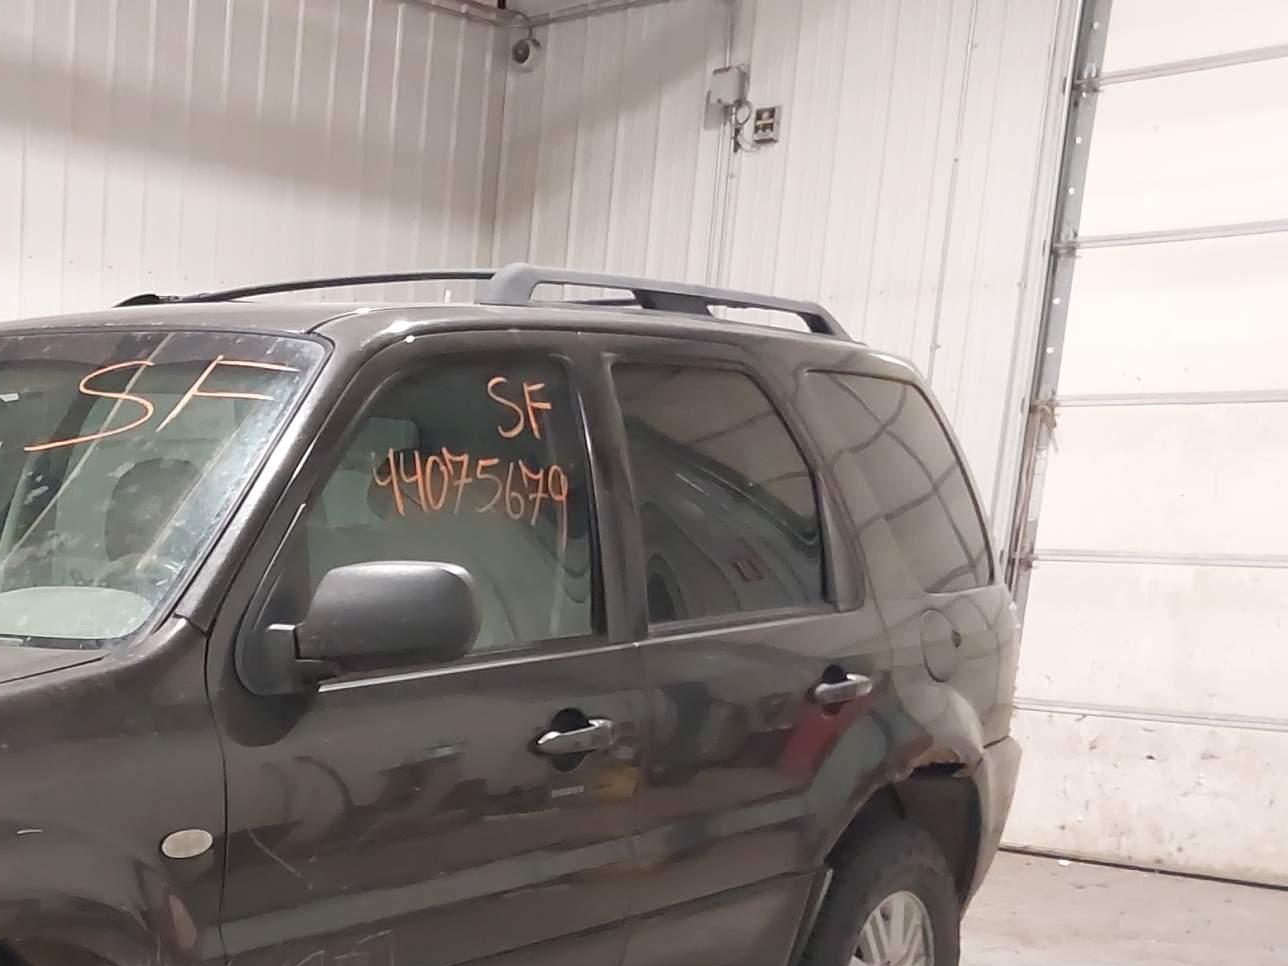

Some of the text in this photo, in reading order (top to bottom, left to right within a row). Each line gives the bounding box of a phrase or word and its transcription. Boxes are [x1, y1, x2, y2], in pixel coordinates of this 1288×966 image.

[23, 354, 301, 452] SF
[487, 376, 552, 440] SF
[371, 447, 568, 551] 44075679
